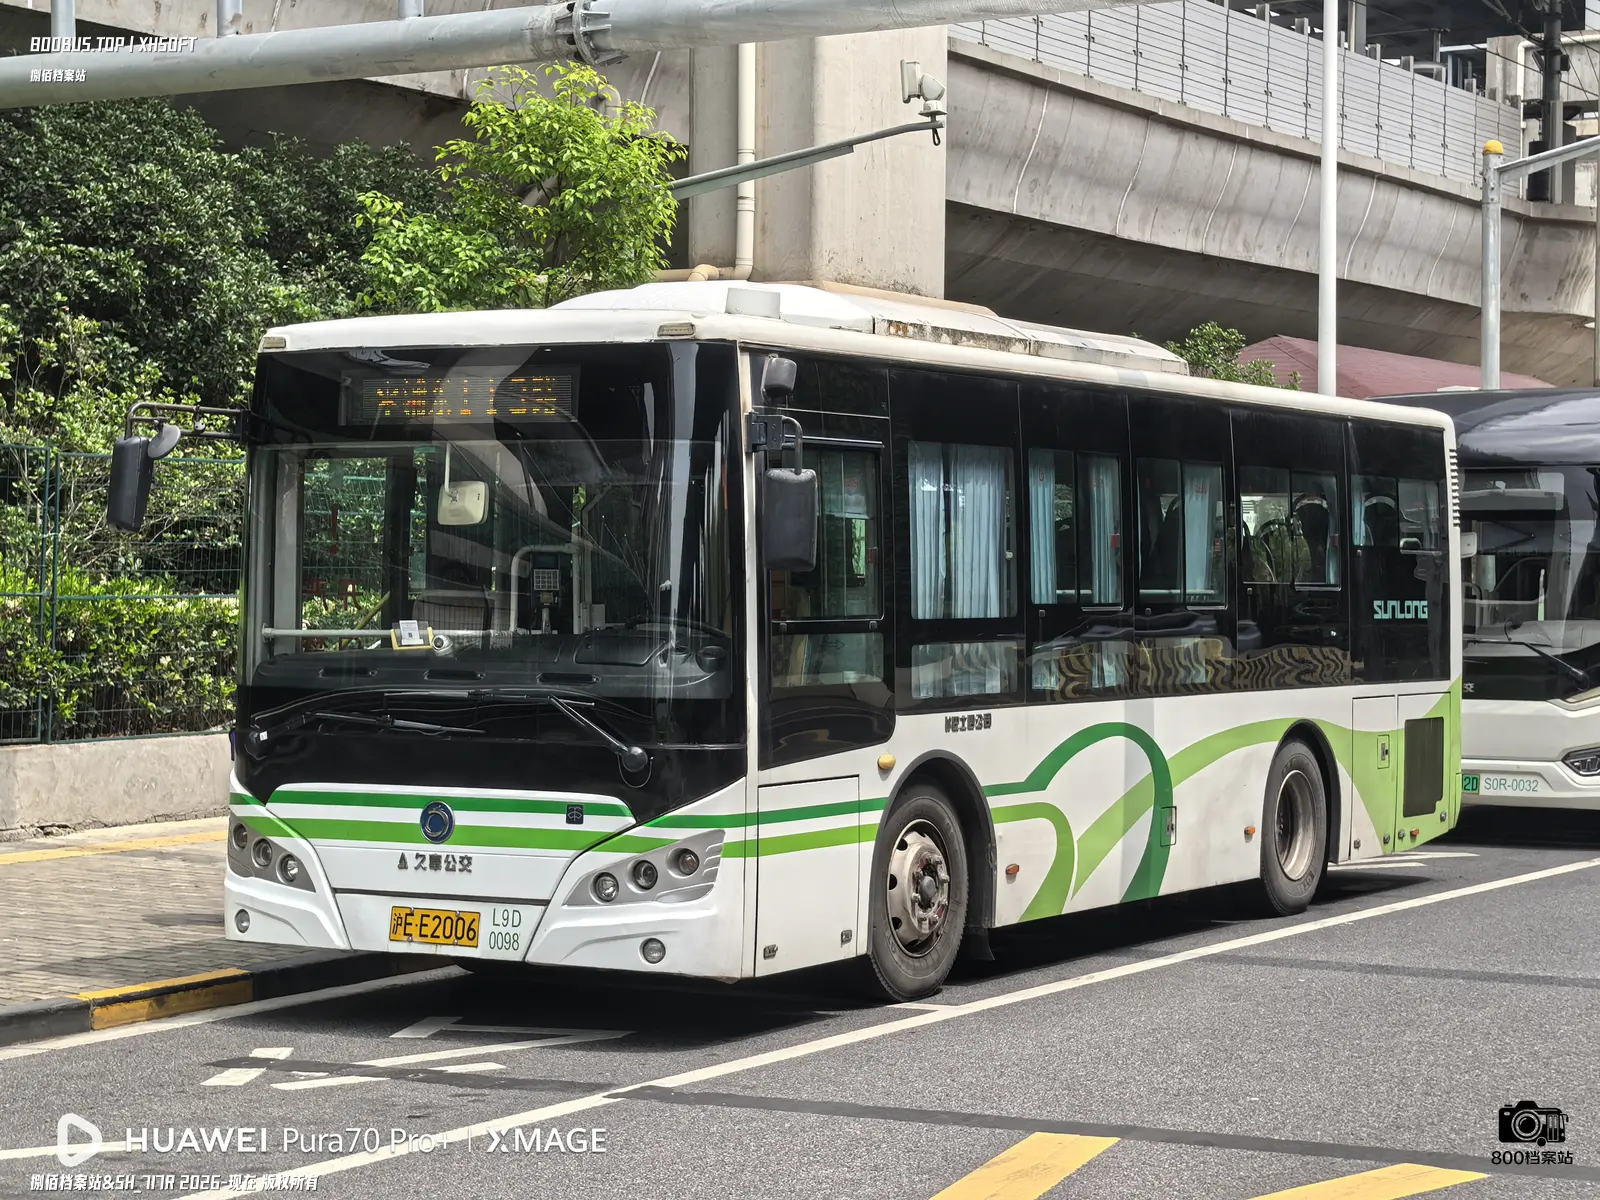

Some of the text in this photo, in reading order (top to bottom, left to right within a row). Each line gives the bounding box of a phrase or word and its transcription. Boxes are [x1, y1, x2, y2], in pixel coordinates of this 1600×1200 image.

[1373, 600, 1429, 619] SUNLONG
[414, 853, 473, 873] 久事公交
[492, 908, 522, 928] L9D
[489, 932, 520, 951] 0098
